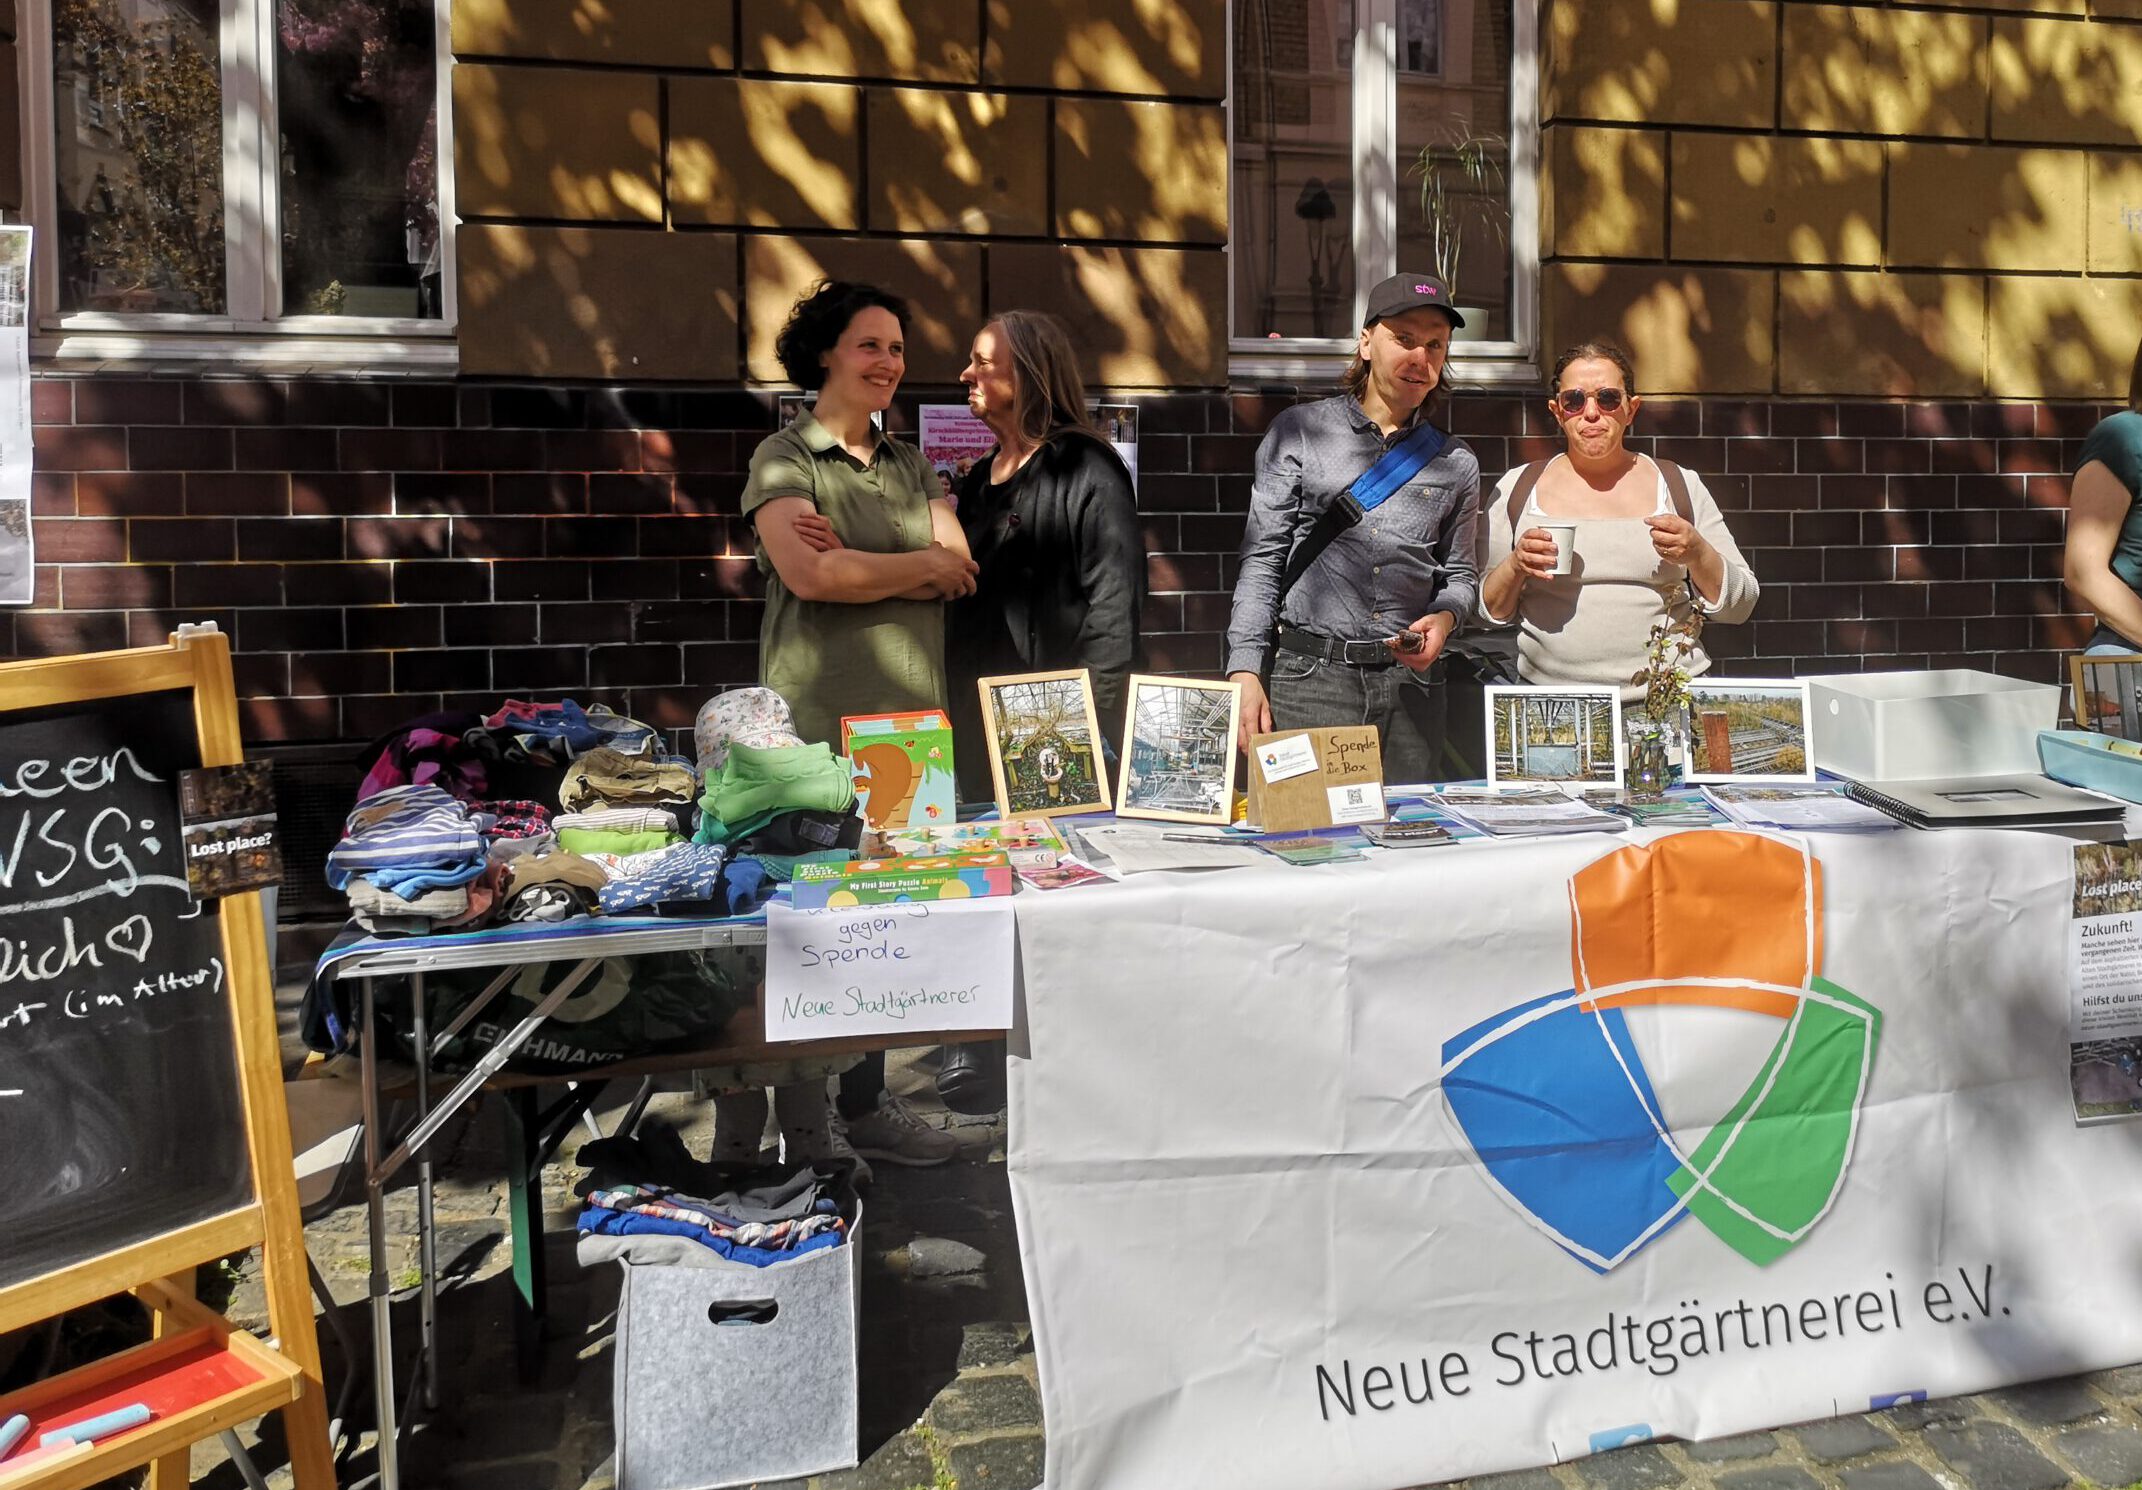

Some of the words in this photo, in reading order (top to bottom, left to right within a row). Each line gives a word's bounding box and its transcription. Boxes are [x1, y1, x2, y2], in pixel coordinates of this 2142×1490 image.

[1328, 735, 1377, 761] Spende
[0, 748, 166, 798] een
[1341, 761, 1368, 774] Box
[191, 841, 225, 858] Lost
[226, 832, 273, 855] place?
[850, 883, 860, 891] My
[878, 881, 896, 889] Story
[2082, 883, 2108, 898] Lost
[2109, 879, 2142, 897] place
[839, 918, 897, 943] gegen
[2081, 920, 2133, 937] Zukunft!
[801, 940, 911, 968] Spende
[782, 993, 836, 1022] Neue
[843, 985, 981, 1019] Stadtgärtnerei
[2083, 995, 2110, 1007] Hilfst
[2112, 993, 2125, 1004] du
[1315, 1350, 1471, 1421] Neue
[1491, 1272, 1902, 1386] Stadtgärtnerei
[1923, 1264, 2011, 1323] e.V.
